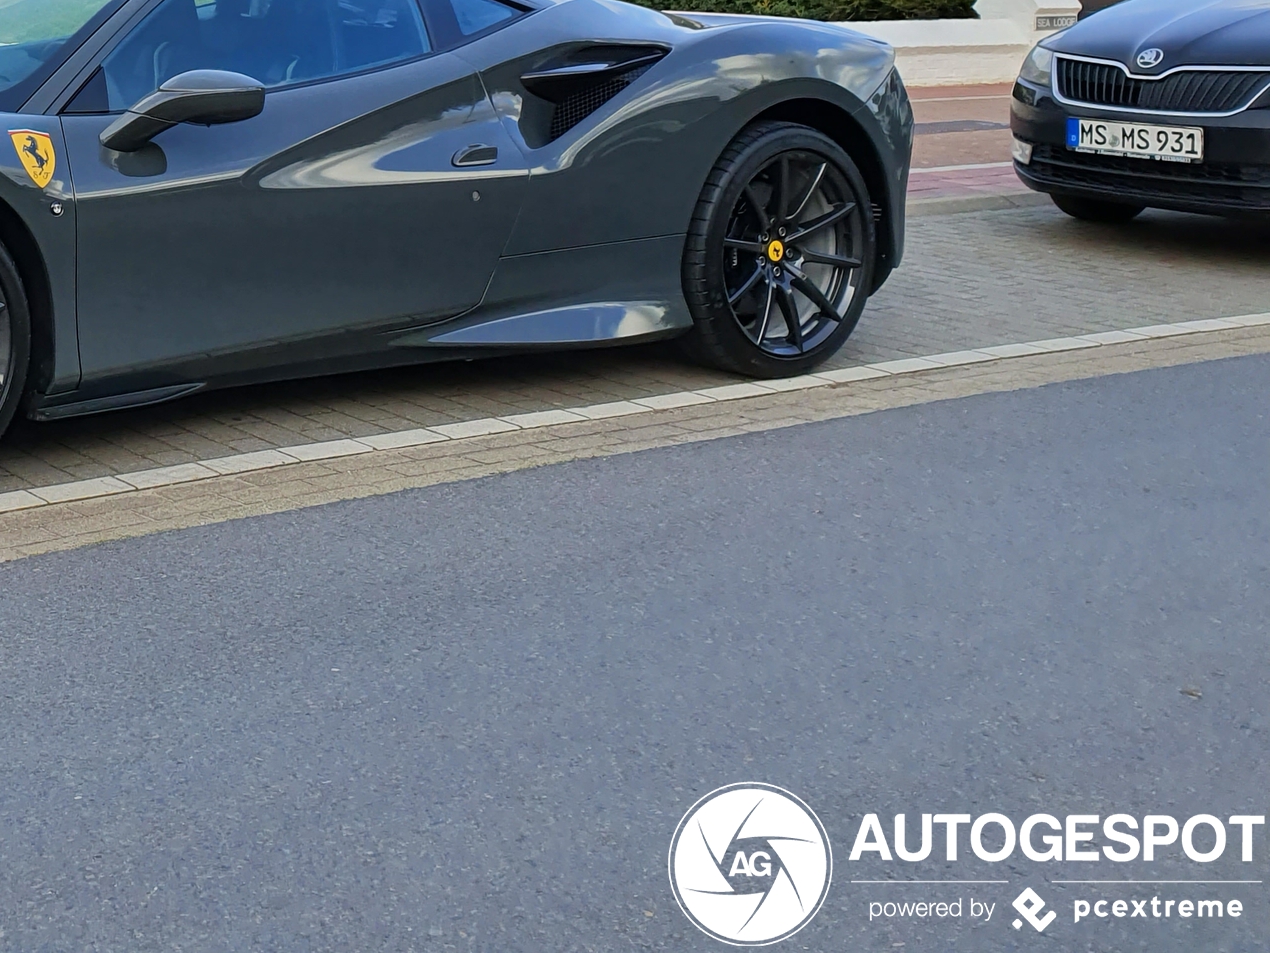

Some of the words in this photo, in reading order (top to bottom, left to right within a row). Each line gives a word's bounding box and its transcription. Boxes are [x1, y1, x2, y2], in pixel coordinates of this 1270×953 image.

[1037, 18, 1050, 27] SEA
[1053, 17, 1076, 27] LODGE
[1080, 122, 1107, 146] MS
[1121, 127, 1150, 150] MS
[1156, 130, 1198, 156] 931
